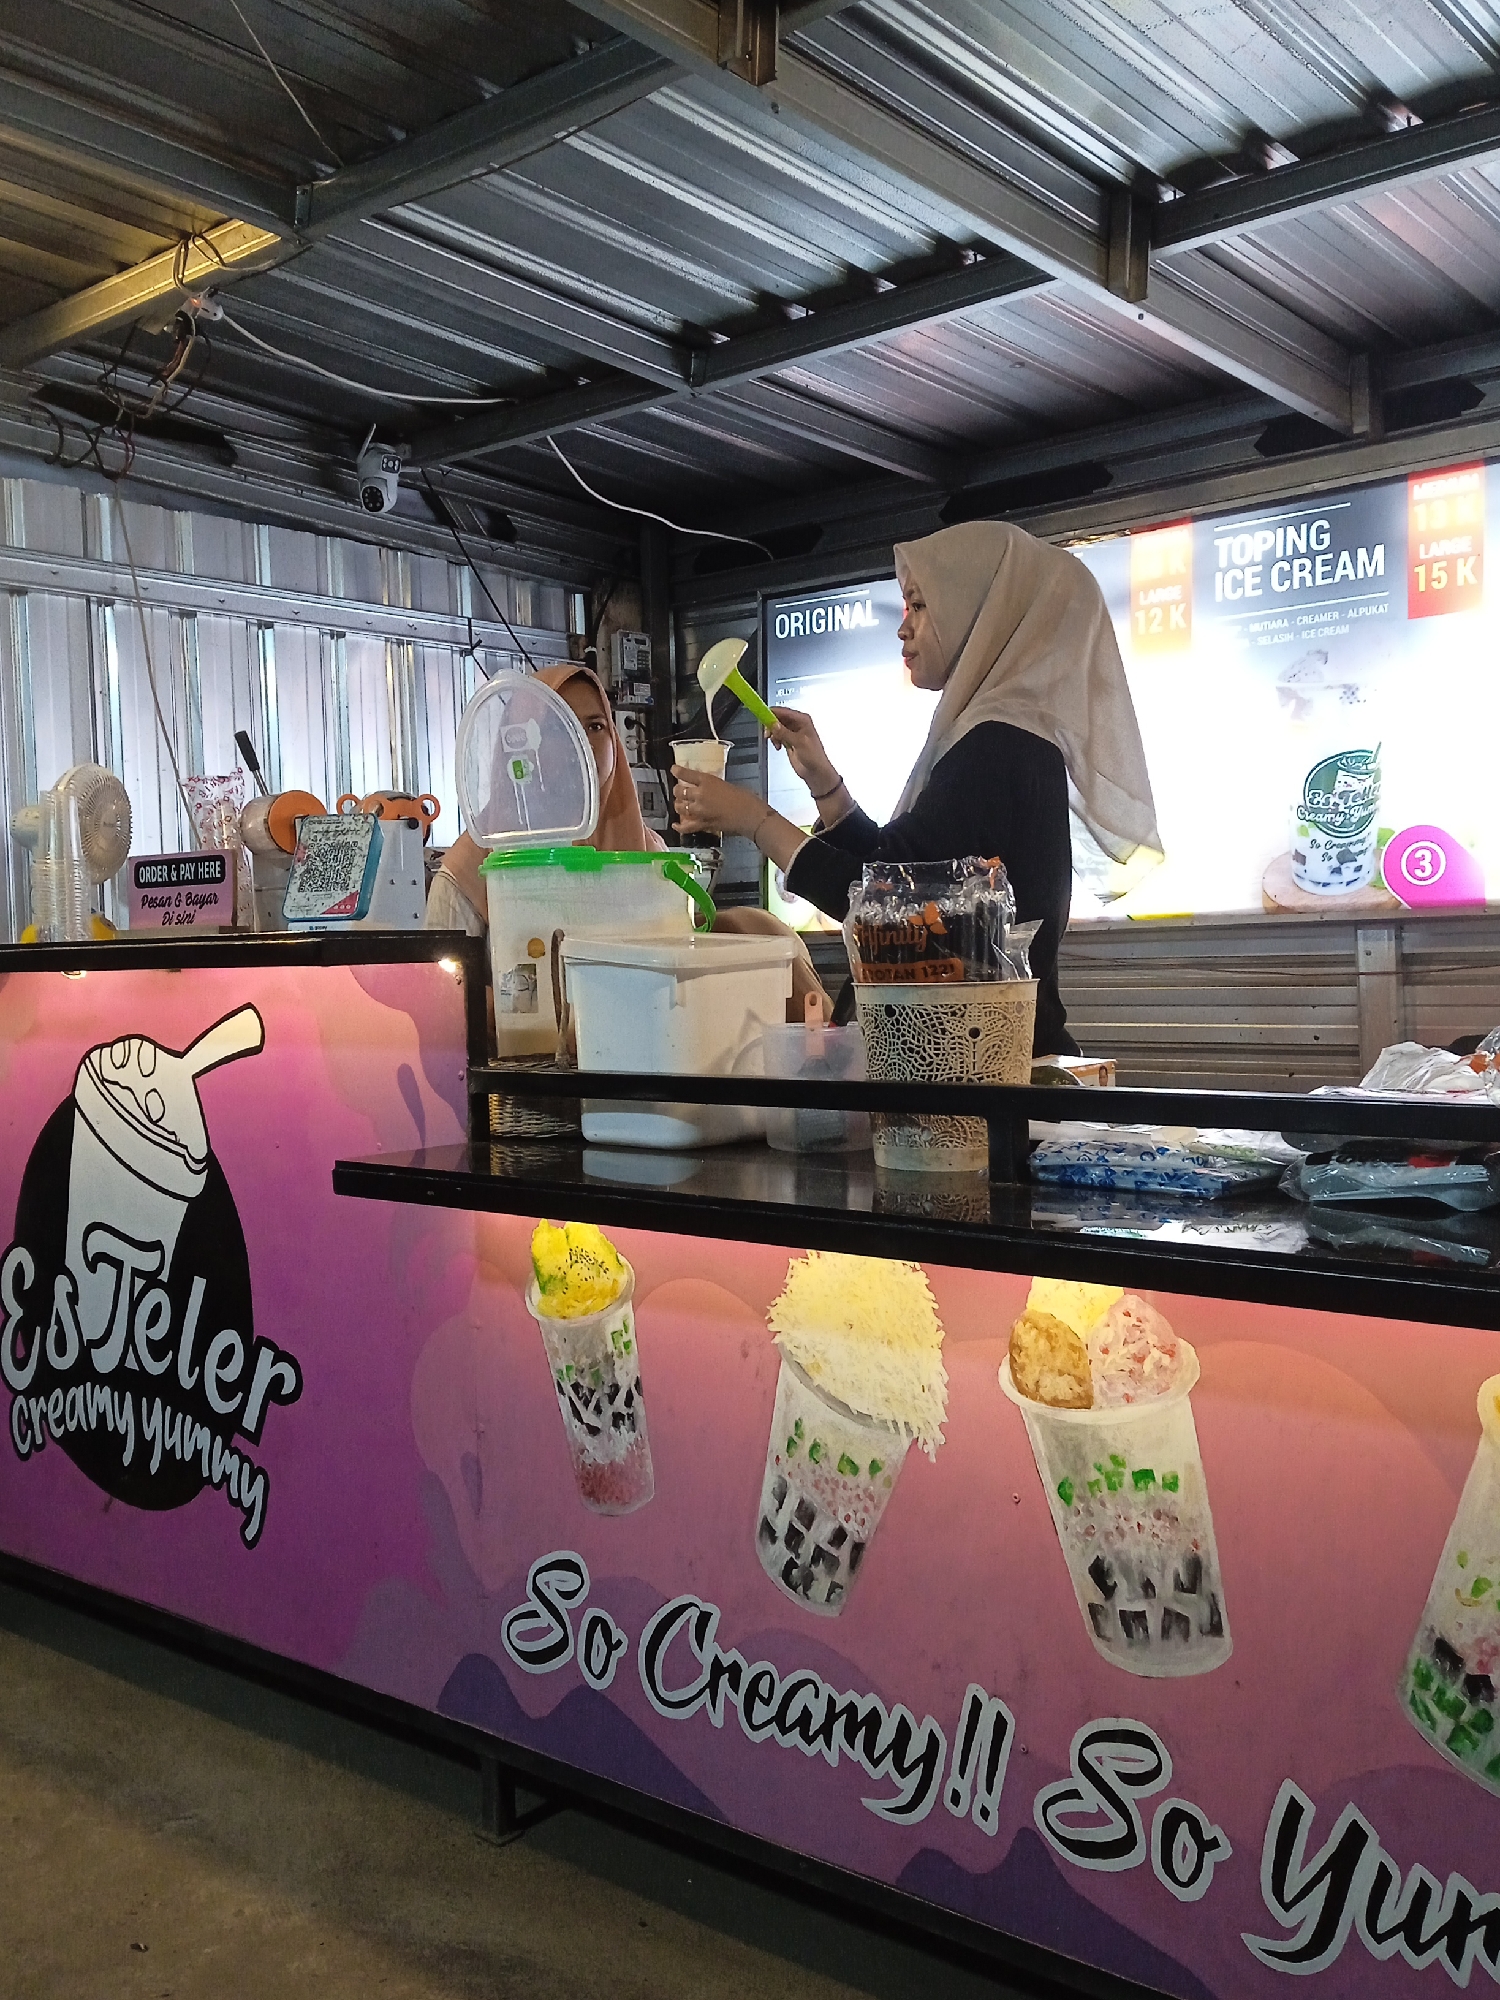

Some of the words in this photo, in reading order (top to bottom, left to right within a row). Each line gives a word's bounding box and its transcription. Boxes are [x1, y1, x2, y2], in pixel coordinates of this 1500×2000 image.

[1213, 519, 1332, 568] TOPING
[1419, 536, 1473, 559] LARGE
[1214, 564, 1264, 603] ICE
[1270, 543, 1386, 592] CREAM
[1413, 561, 1448, 592] 15
[1457, 556, 1478, 587] K
[1139, 584, 1182, 606] LARGE
[775, 599, 880, 639] ORIGINAL
[1135, 607, 1163, 635] 12
[1169, 602, 1187, 631] K
[1249, 618, 1290, 633] MUTIARA
[1296, 611, 1339, 626] CREAMER
[1347, 603, 1389, 619] ALPUKAT
[1256, 631, 1295, 646] SELASIH
[1301, 628, 1316, 640] ICE
[1317, 624, 1350, 637] CREAM
[139, 865, 169, 884] ORDER
[170, 864, 178, 882] &
[180, 862, 196, 881] PAY
[197, 860, 222, 879] HERE
[1414, 848, 1434, 878] 3
[141, 893, 173, 909] Pesan
[184, 891, 220, 909] Bayar
[161, 909, 175, 926] Di
[175, 908, 197, 926] sini
[141, 1395, 265, 1541] yummy
[504, 1555, 626, 1684] So
[641, 1598, 1011, 1829] Creamy!!
[1037, 1722, 1227, 1896] So
